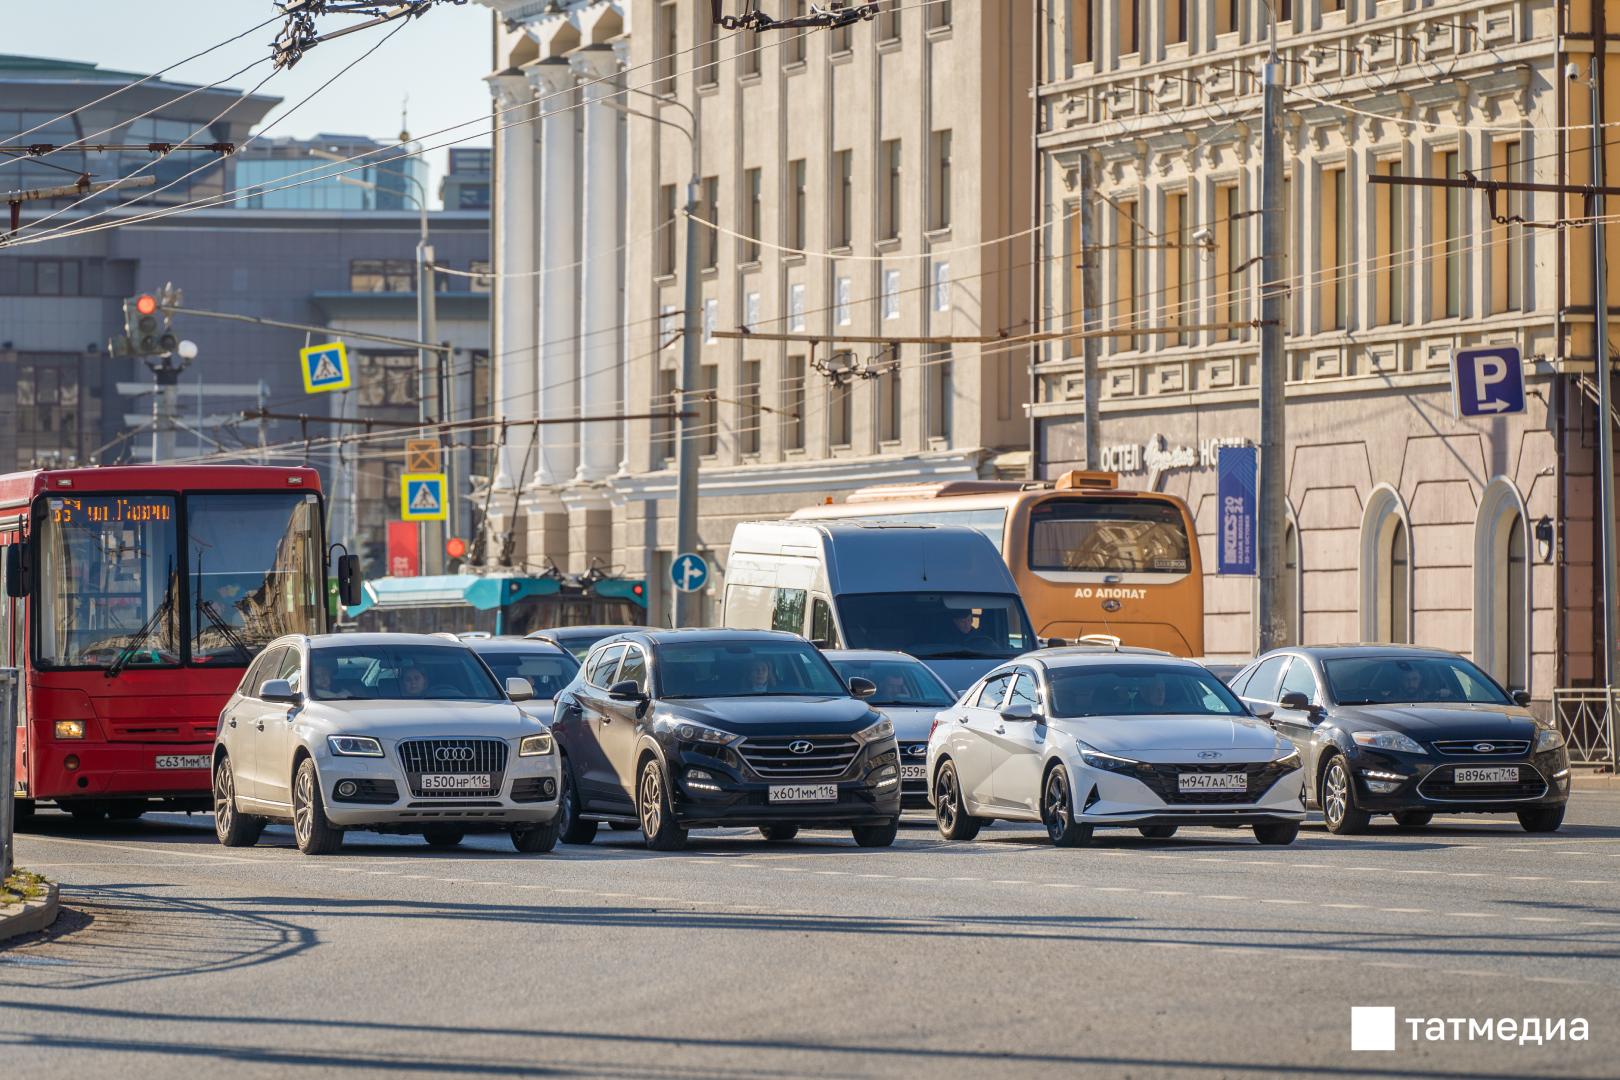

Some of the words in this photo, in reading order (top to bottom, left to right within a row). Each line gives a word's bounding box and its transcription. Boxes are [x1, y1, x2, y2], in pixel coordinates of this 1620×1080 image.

[1474, 356, 1507, 400] P
[1101, 444, 1142, 472] ОСТЕЛ
[1224, 514, 1237, 564] BRICS
[1074, 587, 1093, 599] АО
[1095, 588, 1147, 599] АПОПАТ
[901, 766, 926, 777] 959Р
[1501, 768, 1516, 778] 716
[471, 775, 488, 785] 116
[1227, 774, 1245, 784] 716
[818, 786, 834, 795] 116
